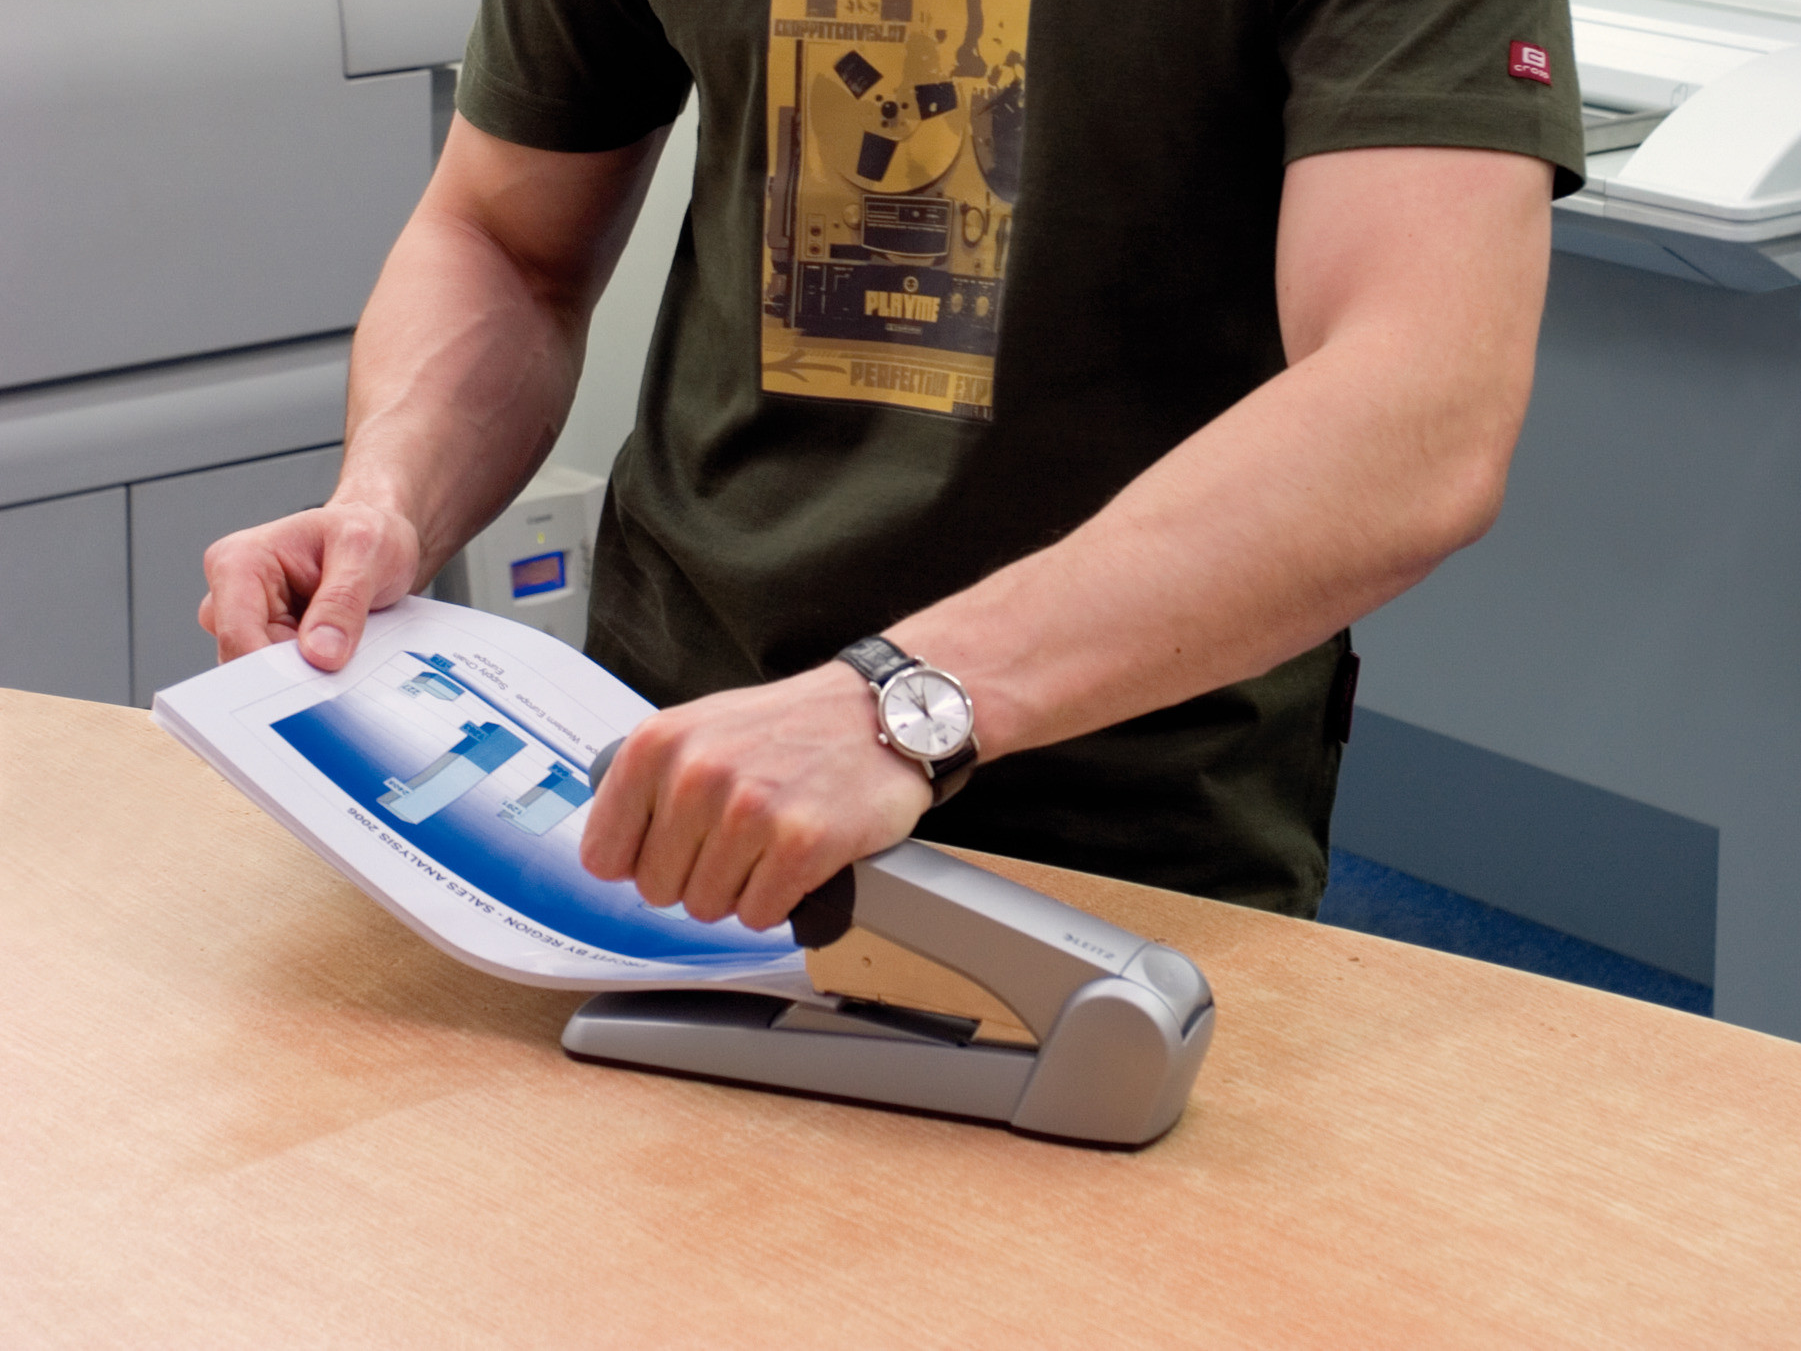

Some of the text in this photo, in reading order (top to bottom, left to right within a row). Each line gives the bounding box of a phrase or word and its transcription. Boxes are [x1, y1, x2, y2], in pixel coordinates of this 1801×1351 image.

[479, 667, 509, 691] Supply
[515, 693, 581, 745] Western Europe
[347, 807, 379, 833] 2006
[378, 832, 446, 887] ANALYSIS
[446, 881, 495, 914] SALES
[503, 915, 564, 949] REGION
[563, 945, 588, 957] BY
